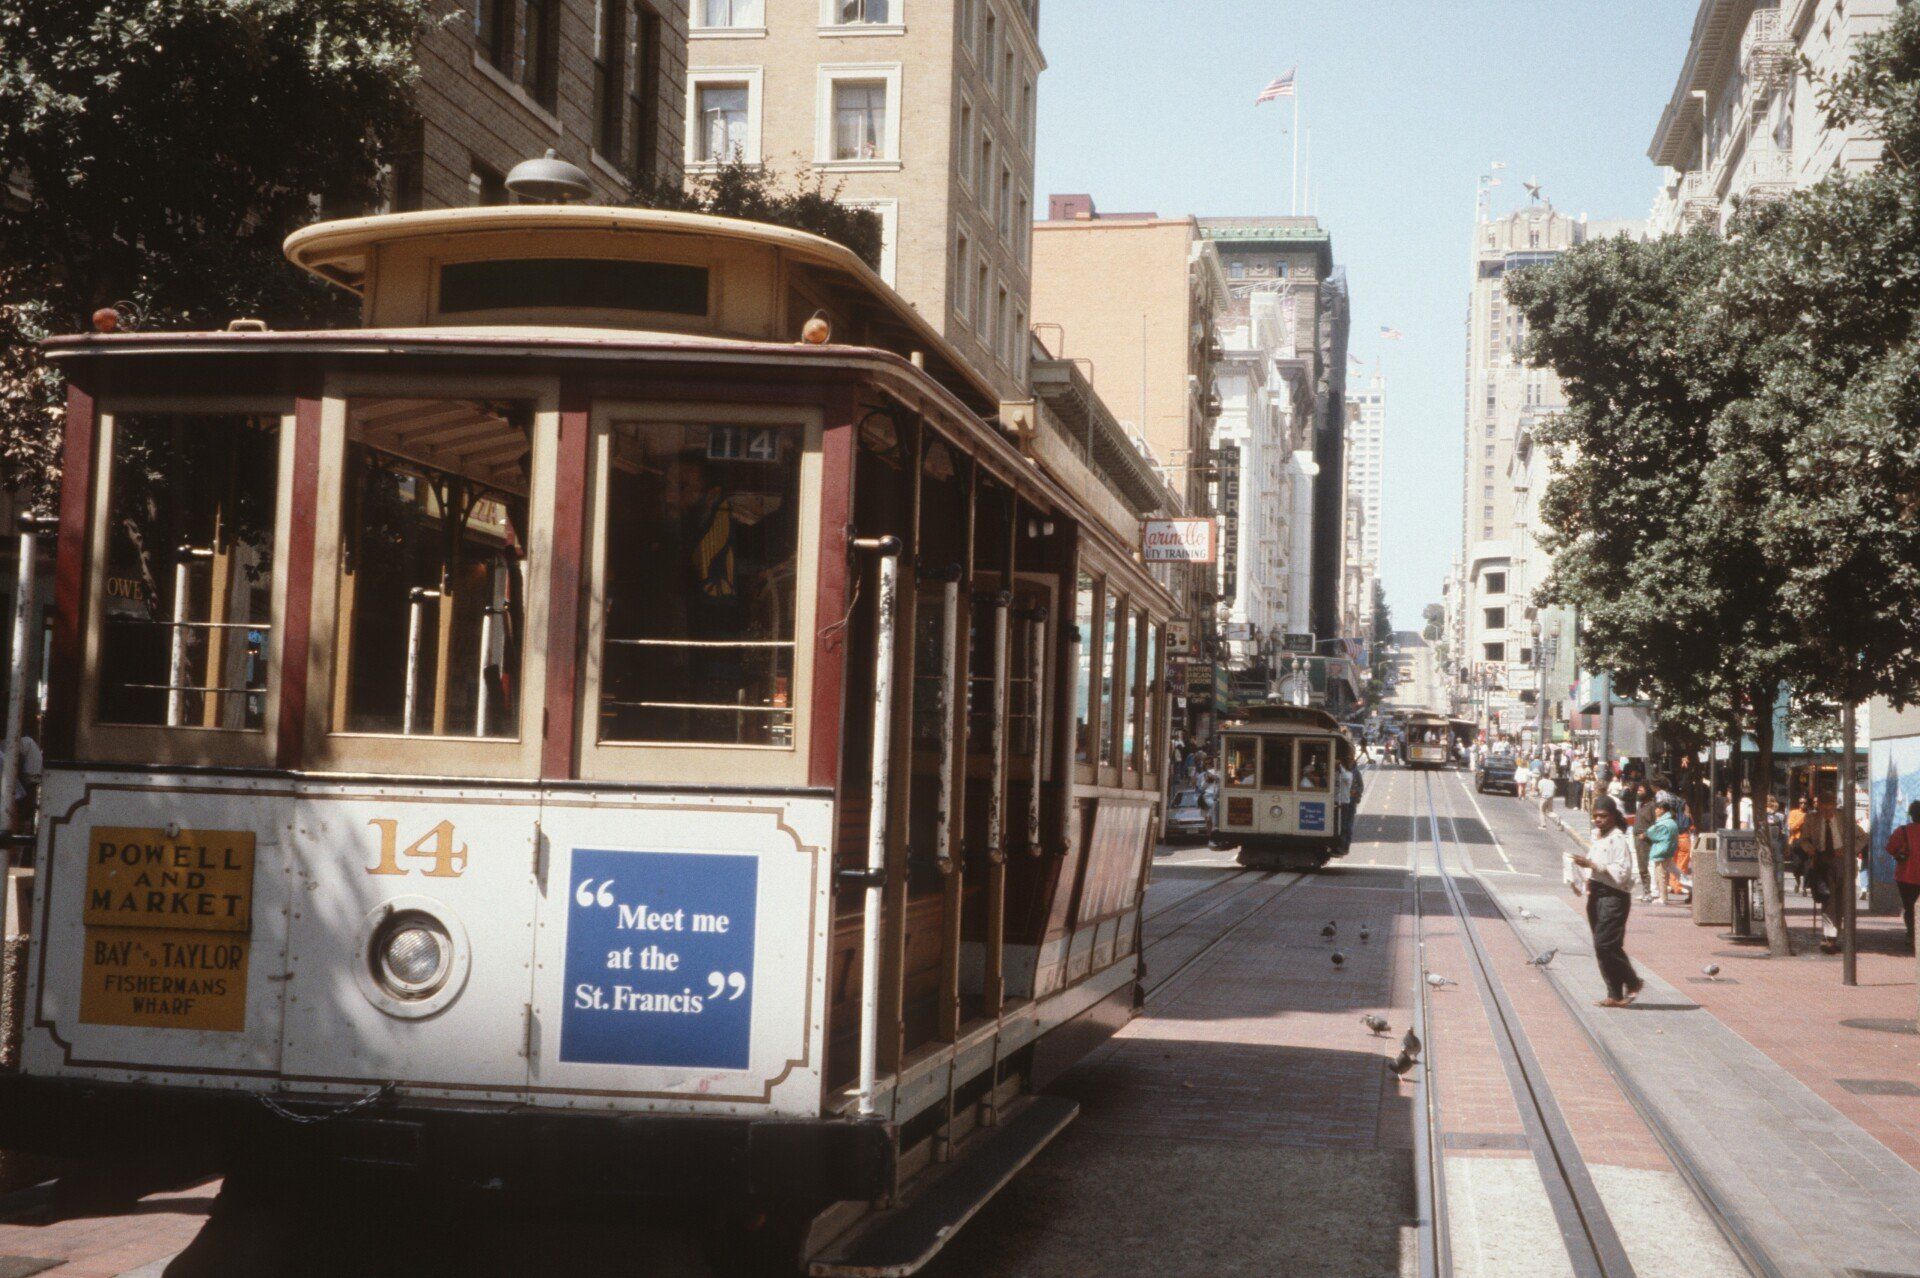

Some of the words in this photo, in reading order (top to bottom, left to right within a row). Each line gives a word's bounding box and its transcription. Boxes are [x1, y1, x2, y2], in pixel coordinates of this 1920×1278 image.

[722, 428, 774, 460] 14
[1225, 463, 1240, 585] HERBERT
[1165, 549, 1206, 559] TRAINING
[98, 842, 242, 870] POWELL
[365, 818, 468, 878] 14
[134, 871, 206, 889] AND
[91, 888, 243, 916] MARKET
[691, 913, 730, 933] me
[94, 940, 132, 966] BAY
[162, 942, 243, 970] TAYLOR
[606, 946, 633, 969] at
[640, 945, 679, 971] the
[104, 974, 227, 996] FISHERMANS
[575, 983, 610, 1010] St.
[132, 996, 195, 1014] WHARF
